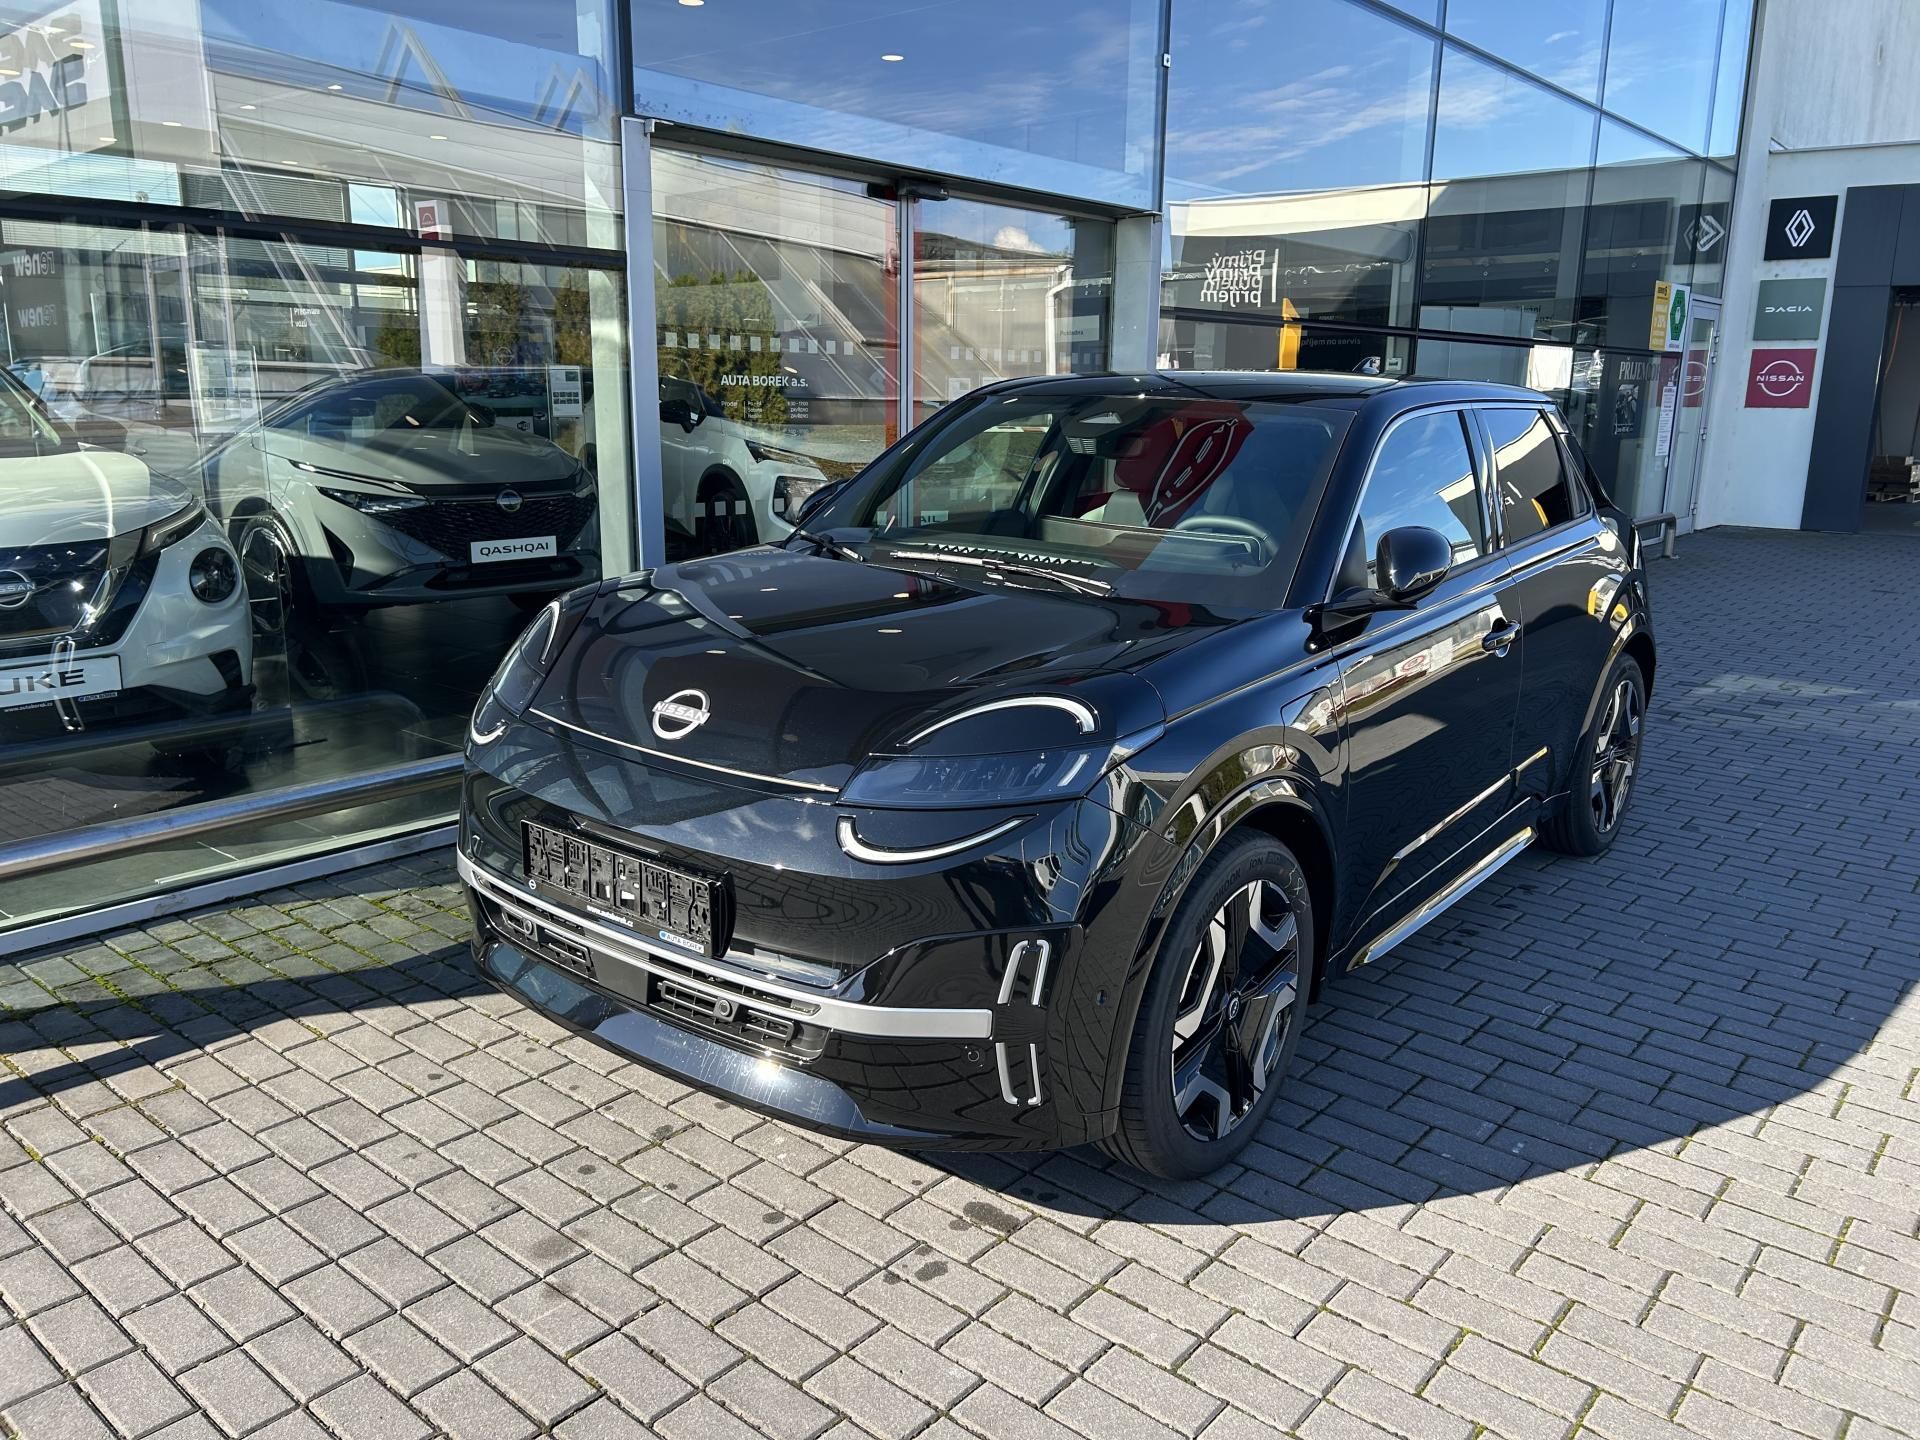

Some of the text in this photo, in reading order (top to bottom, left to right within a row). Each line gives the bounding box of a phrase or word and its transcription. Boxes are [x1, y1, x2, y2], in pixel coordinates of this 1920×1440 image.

[721, 375, 809, 387] AUTA BOREK a.s.
[480, 542, 549, 557] QASHQAI
[651, 700, 711, 725] NISSAN
